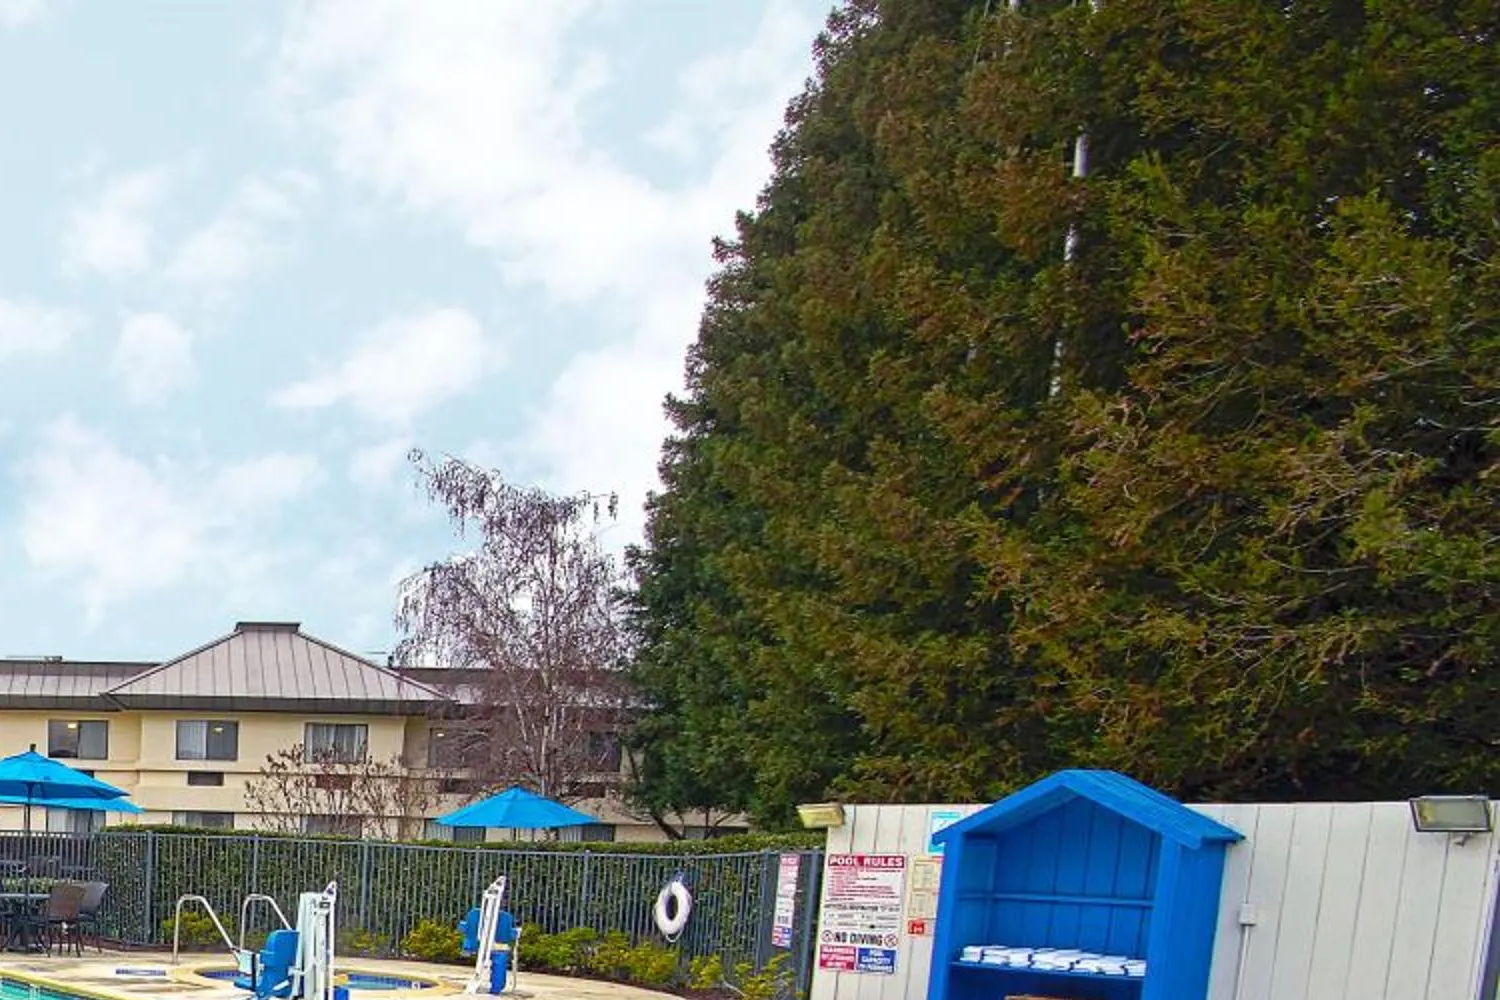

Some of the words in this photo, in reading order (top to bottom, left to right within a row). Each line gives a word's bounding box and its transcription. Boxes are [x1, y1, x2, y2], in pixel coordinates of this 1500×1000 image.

[828, 855, 858, 868] POOL
[863, 857, 903, 869] RULES
[849, 932, 883, 947] DIVING
